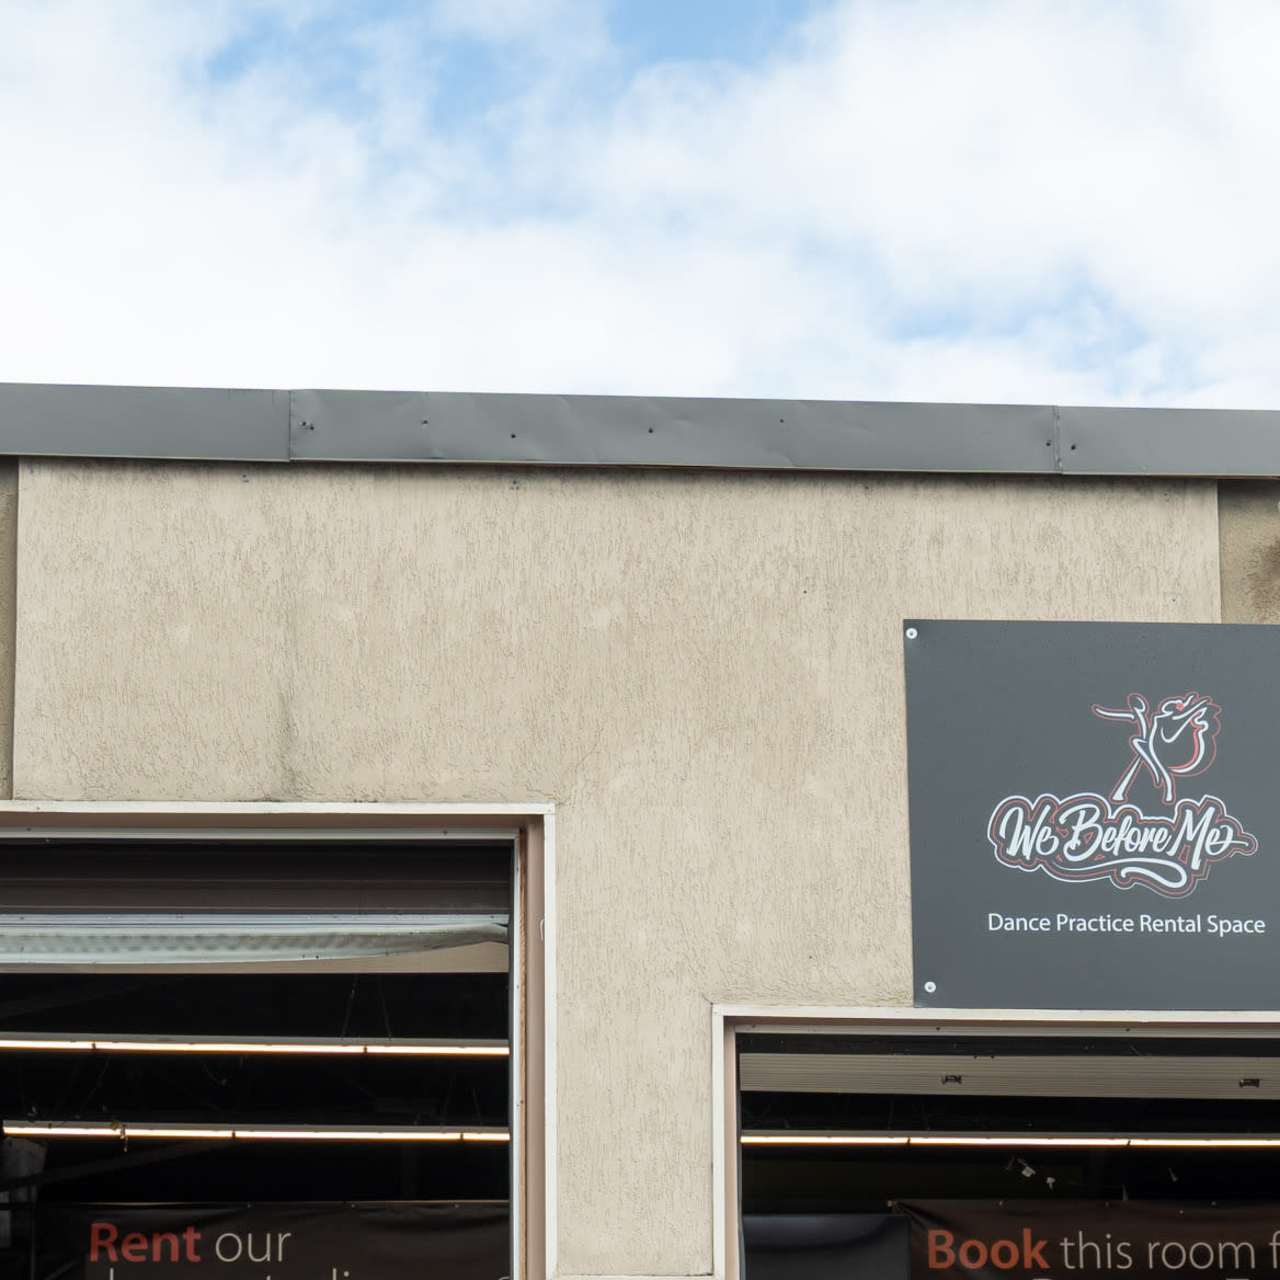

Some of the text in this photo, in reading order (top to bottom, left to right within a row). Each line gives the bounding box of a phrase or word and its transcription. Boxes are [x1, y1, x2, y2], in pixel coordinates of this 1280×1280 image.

[998, 803, 1250, 870] We Before Me
[987, 913, 1267, 937] Dance Practice Rental Space
[88, 1221, 292, 1263] Rent our
[926, 1227, 1051, 1270] Book
[1059, 1230, 1133, 1270] this
[1147, 1239, 1256, 1270] room
